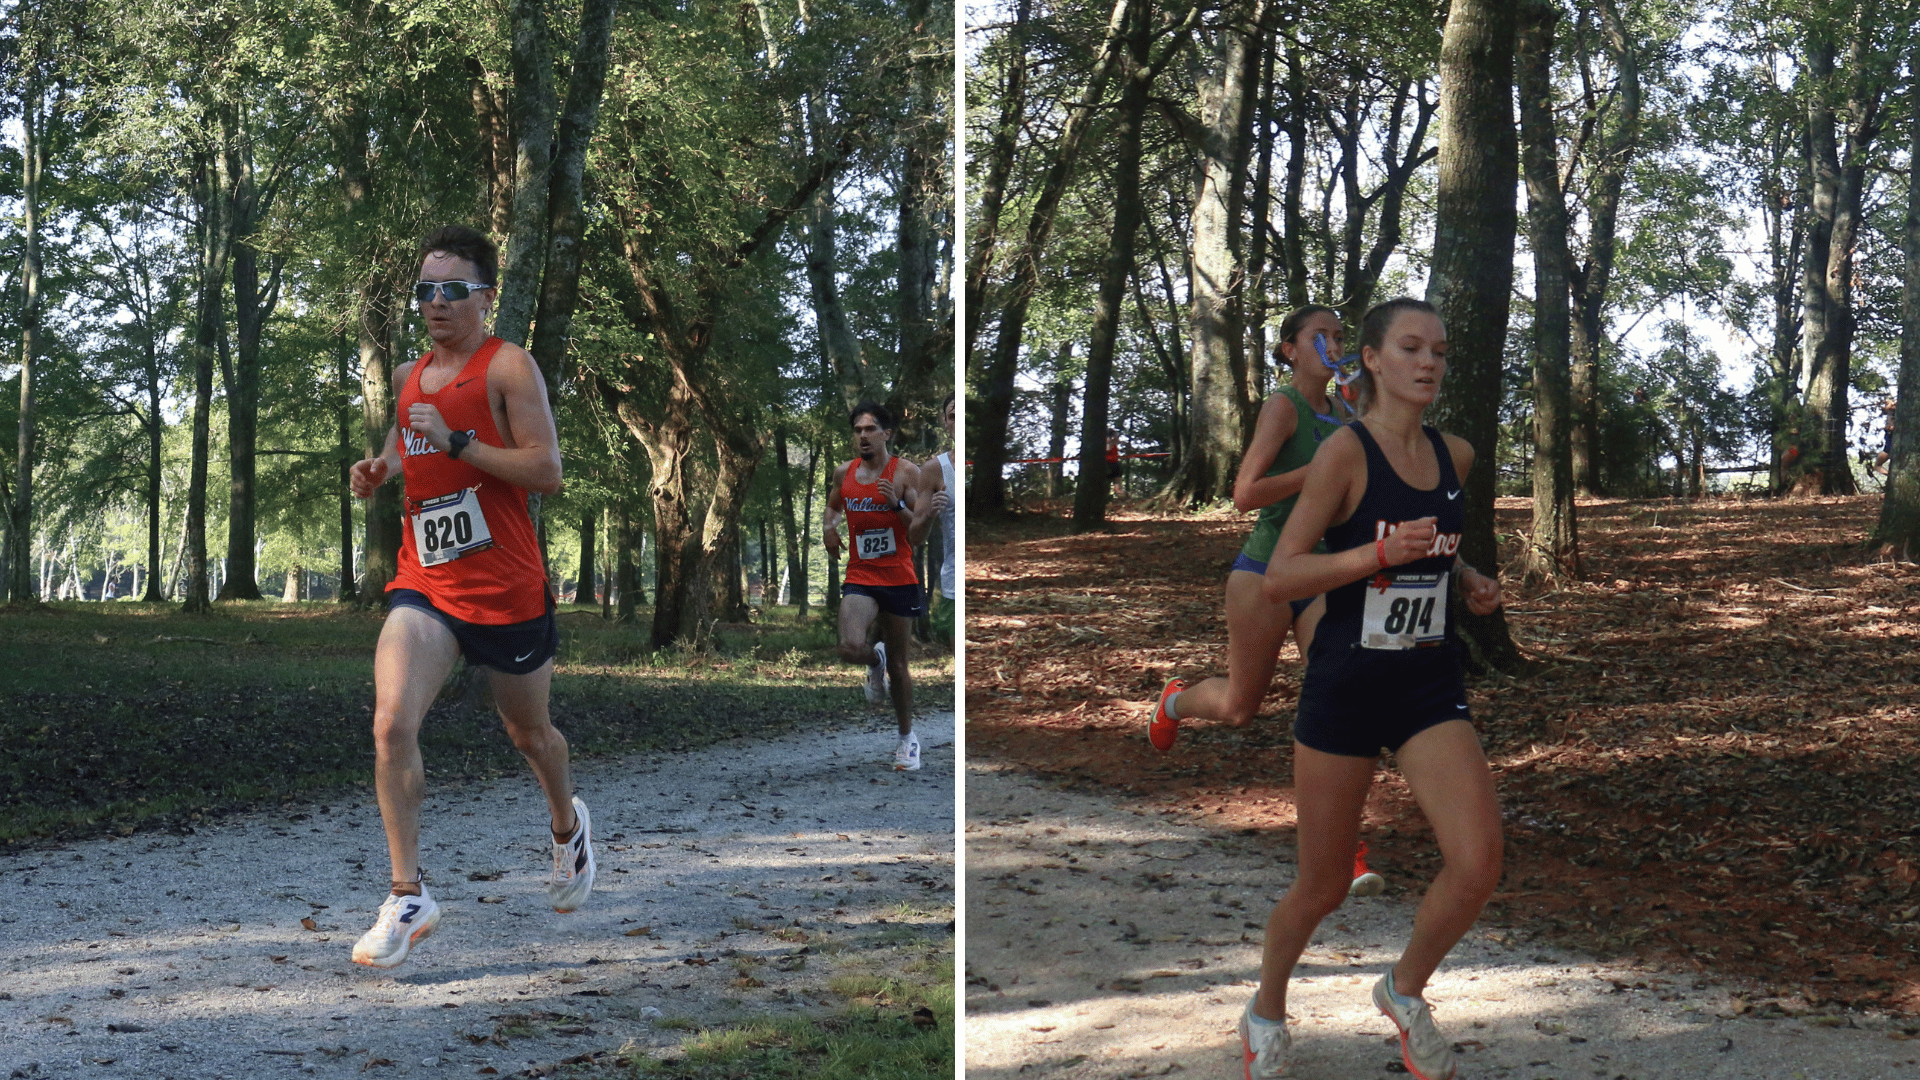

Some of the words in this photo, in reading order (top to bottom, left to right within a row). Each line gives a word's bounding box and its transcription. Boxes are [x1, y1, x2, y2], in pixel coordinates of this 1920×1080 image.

[844, 497, 890, 512] Wallace
[424, 511, 472, 552] 820
[863, 537, 888, 553] 825
[1385, 597, 1436, 634] 814
